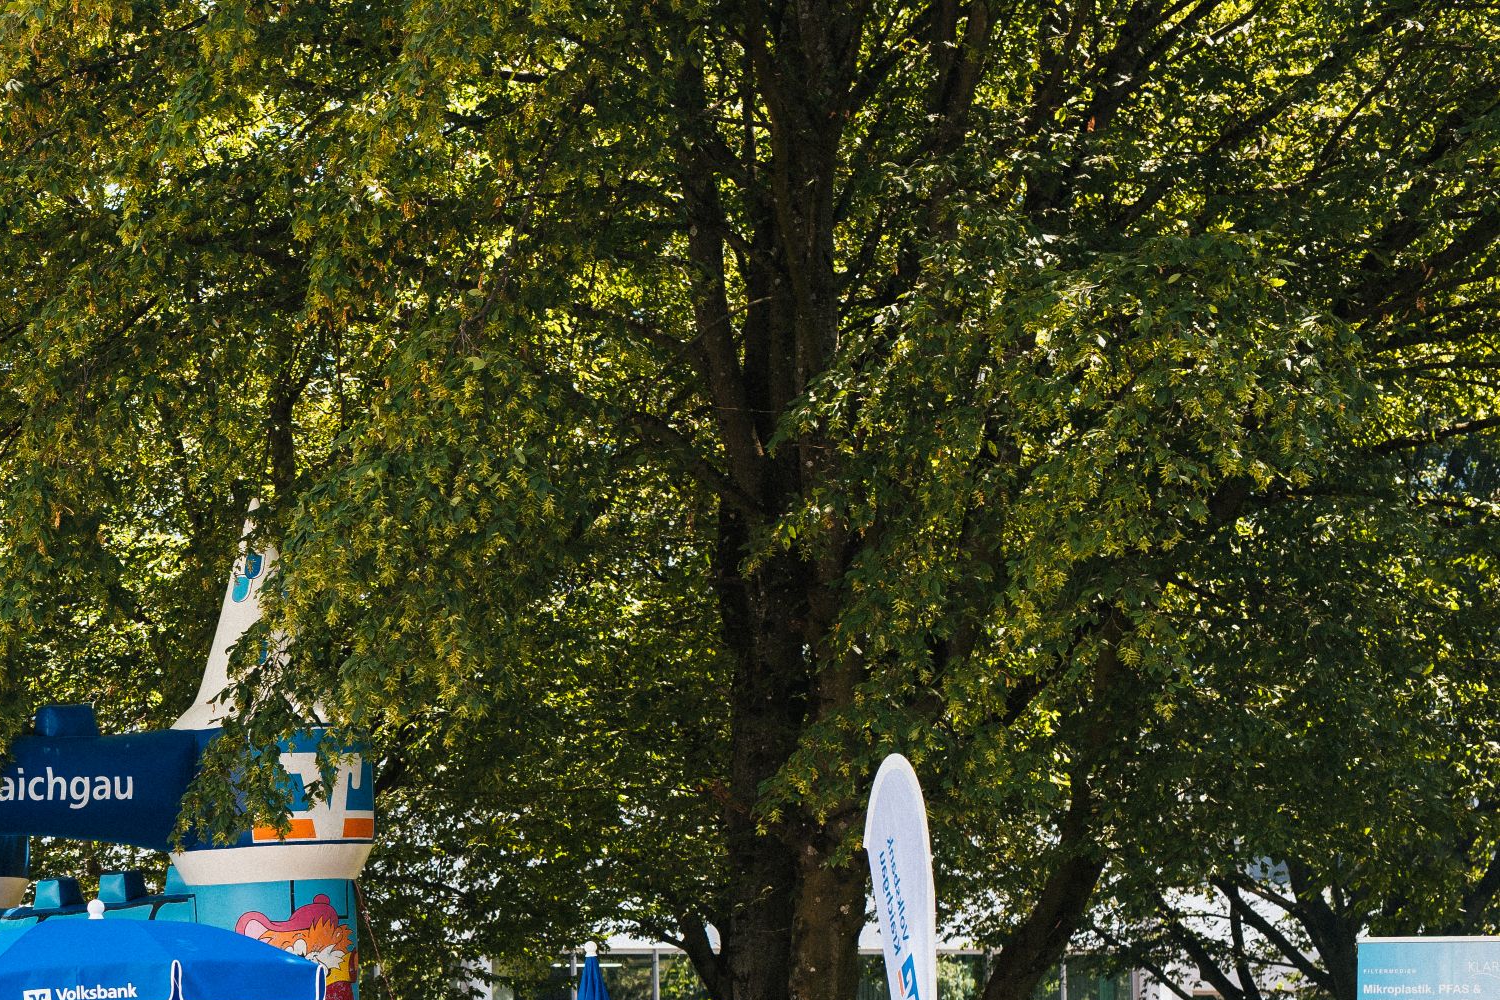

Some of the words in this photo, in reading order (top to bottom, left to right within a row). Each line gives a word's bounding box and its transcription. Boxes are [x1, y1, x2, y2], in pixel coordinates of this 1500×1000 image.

[1363, 984, 1435, 996] Mikroplastik,
[1439, 984, 1470, 995] PFAS
[1473, 985, 1481, 994] &
